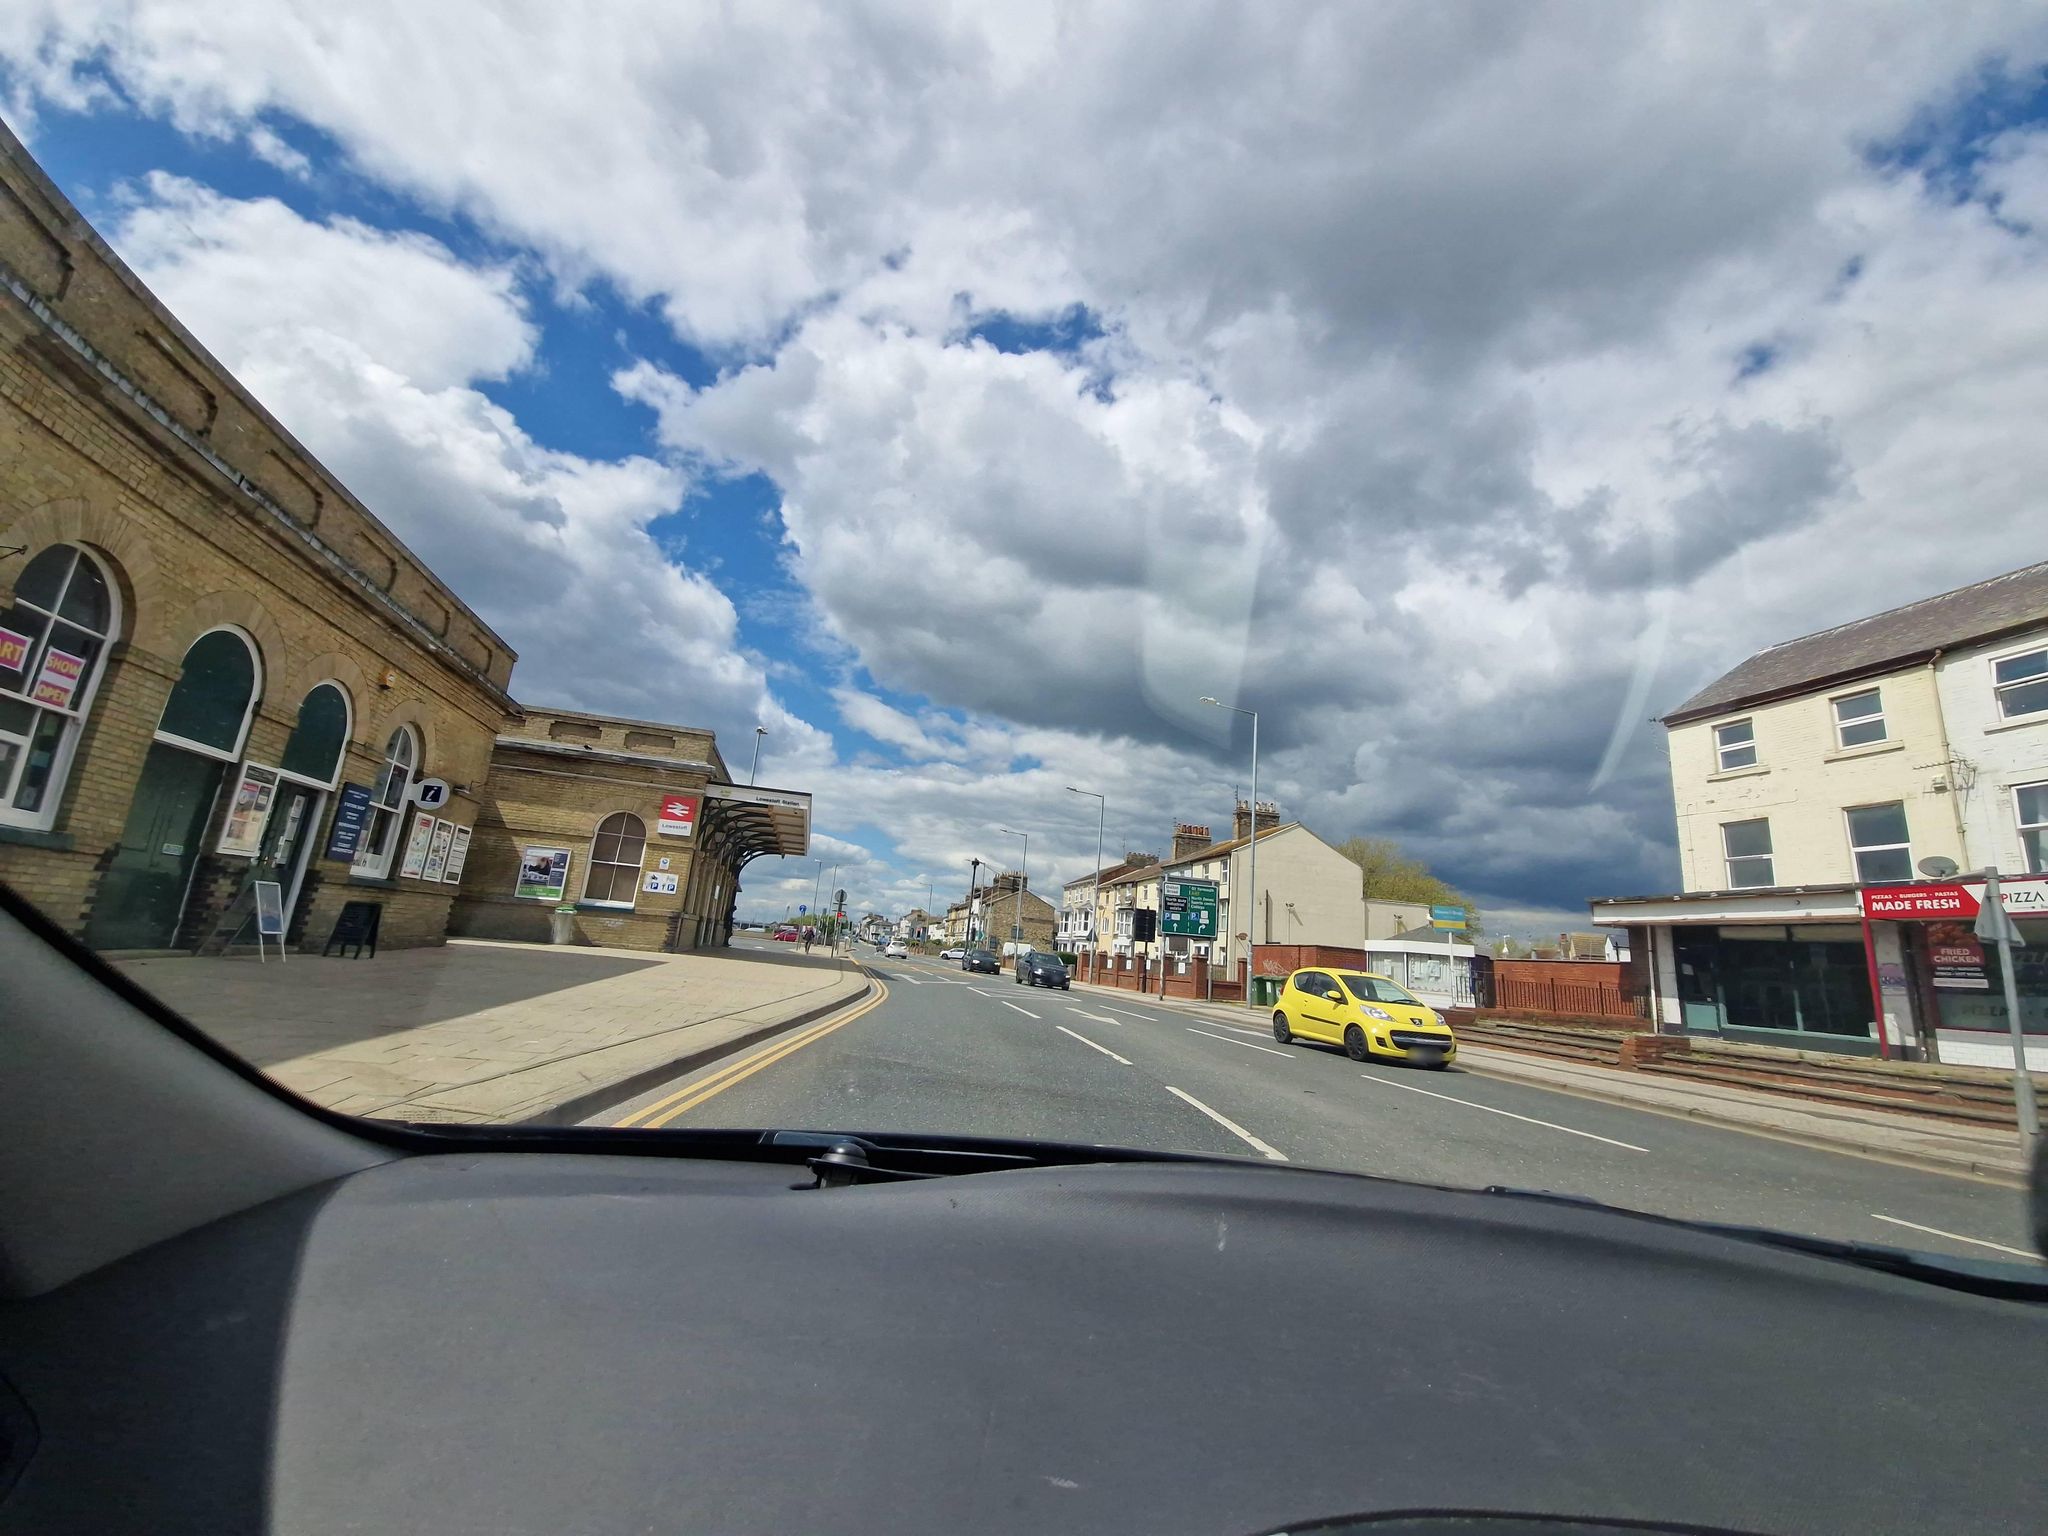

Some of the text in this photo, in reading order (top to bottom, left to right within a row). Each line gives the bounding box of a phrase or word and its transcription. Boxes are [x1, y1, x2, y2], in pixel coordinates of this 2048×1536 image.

[47, 657, 81, 676] SHOW
[37, 684, 67, 703] OPEN
[755, 796, 780, 804] Lowestoft
[2001, 891, 2045, 904] PIZZA
[1872, 898, 1961, 911] MADE FRESH
[1941, 948, 1970, 956] FRIED
[1933, 955, 1981, 963] CHICKEN
